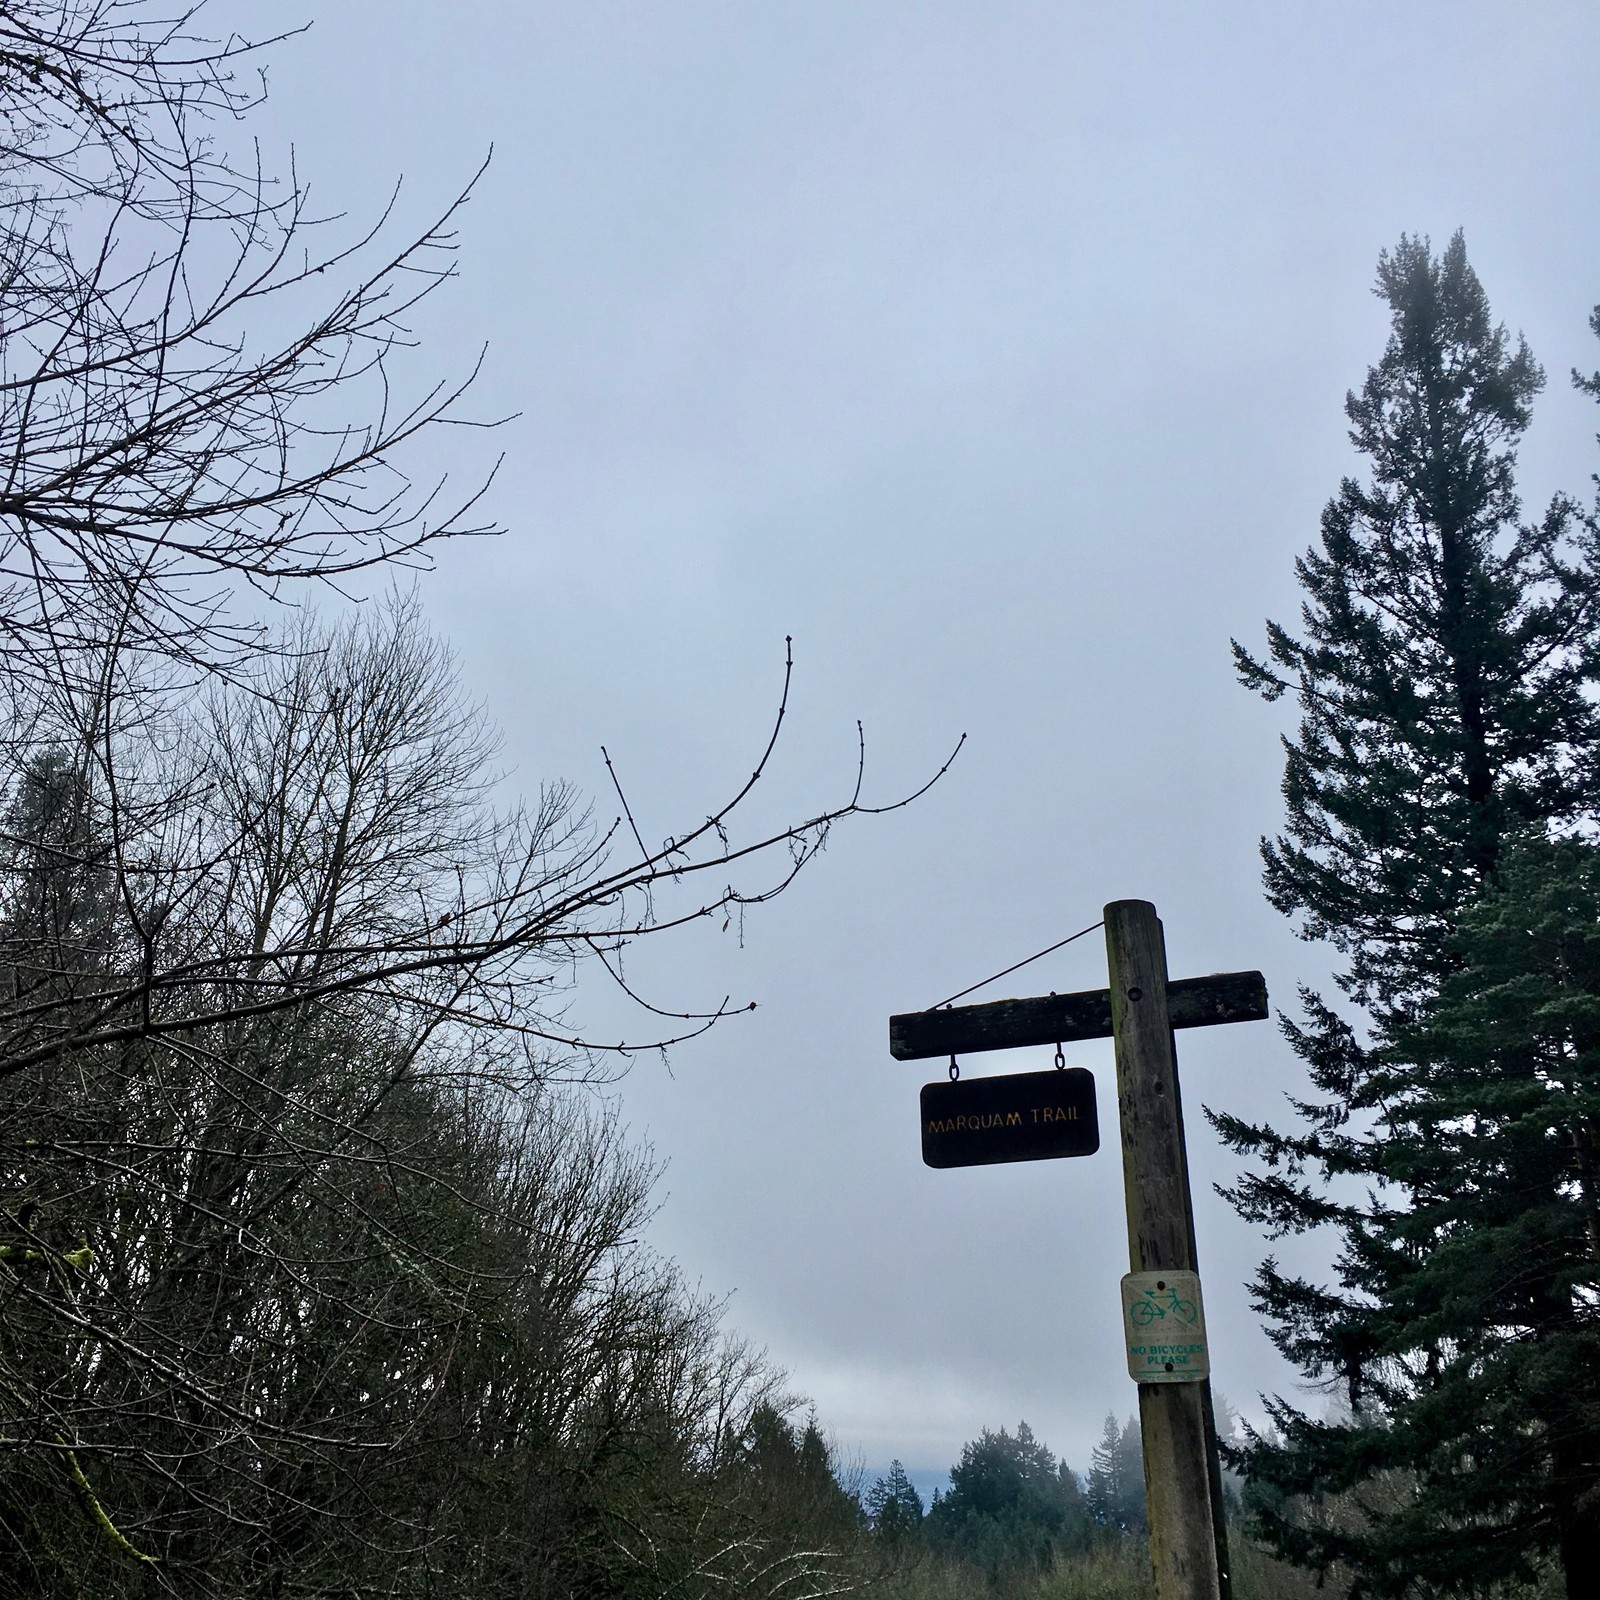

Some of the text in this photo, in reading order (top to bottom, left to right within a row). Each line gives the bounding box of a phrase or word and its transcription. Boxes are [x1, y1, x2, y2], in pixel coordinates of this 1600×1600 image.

[928, 1106, 1079, 1134] MARQUAM TRAIL
[1130, 1344, 1204, 1355] NO BICYCLES
[1147, 1355, 1188, 1365] PLEASE
